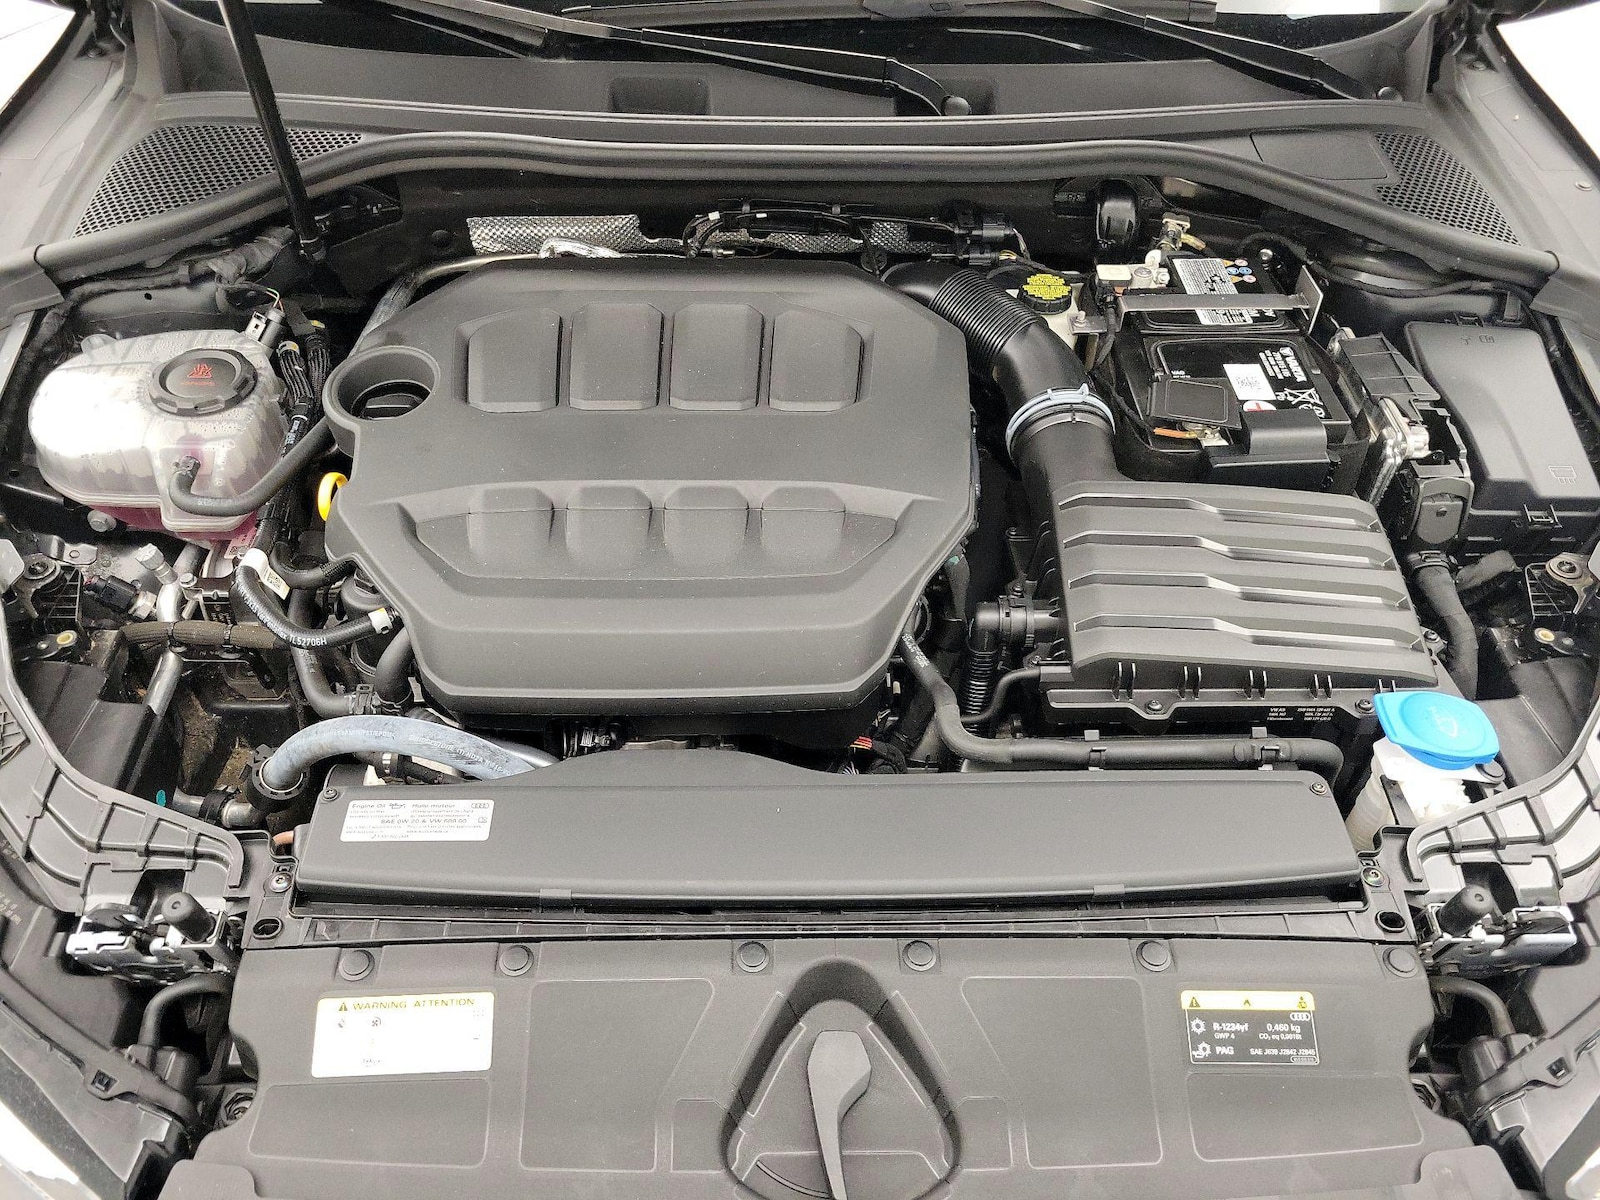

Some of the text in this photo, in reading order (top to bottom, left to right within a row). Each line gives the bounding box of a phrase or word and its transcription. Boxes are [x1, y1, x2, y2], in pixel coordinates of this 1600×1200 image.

[1285, 356, 1307, 382] VARTA
[353, 998, 475, 1011] WARNING ATTENTION
[1212, 1022, 1250, 1033] R-1234yf
[1290, 1023, 1301, 1033] kg
[1215, 1046, 1235, 1055] PAG
